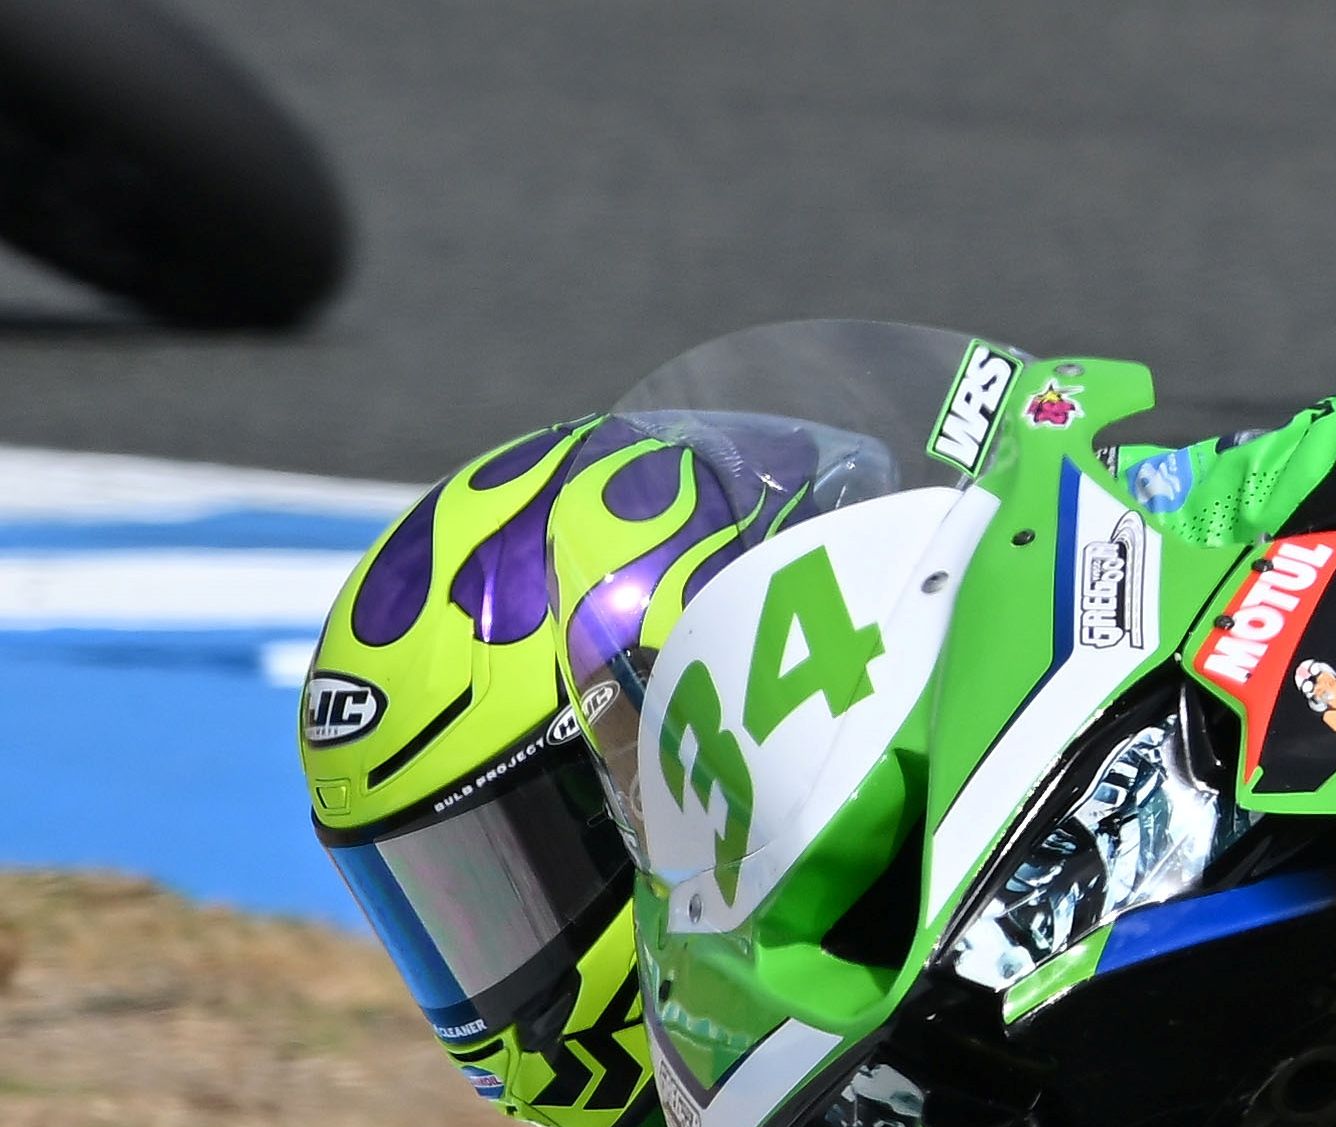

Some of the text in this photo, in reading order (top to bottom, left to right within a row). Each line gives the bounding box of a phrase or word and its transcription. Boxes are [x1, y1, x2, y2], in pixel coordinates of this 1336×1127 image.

[934, 344, 1013, 468] WRS
[1203, 542, 1334, 686] MOTUL
[308, 690, 369, 727] JC
[475, 738, 546, 789] PROJECT
[659, 545, 886, 907] 34
